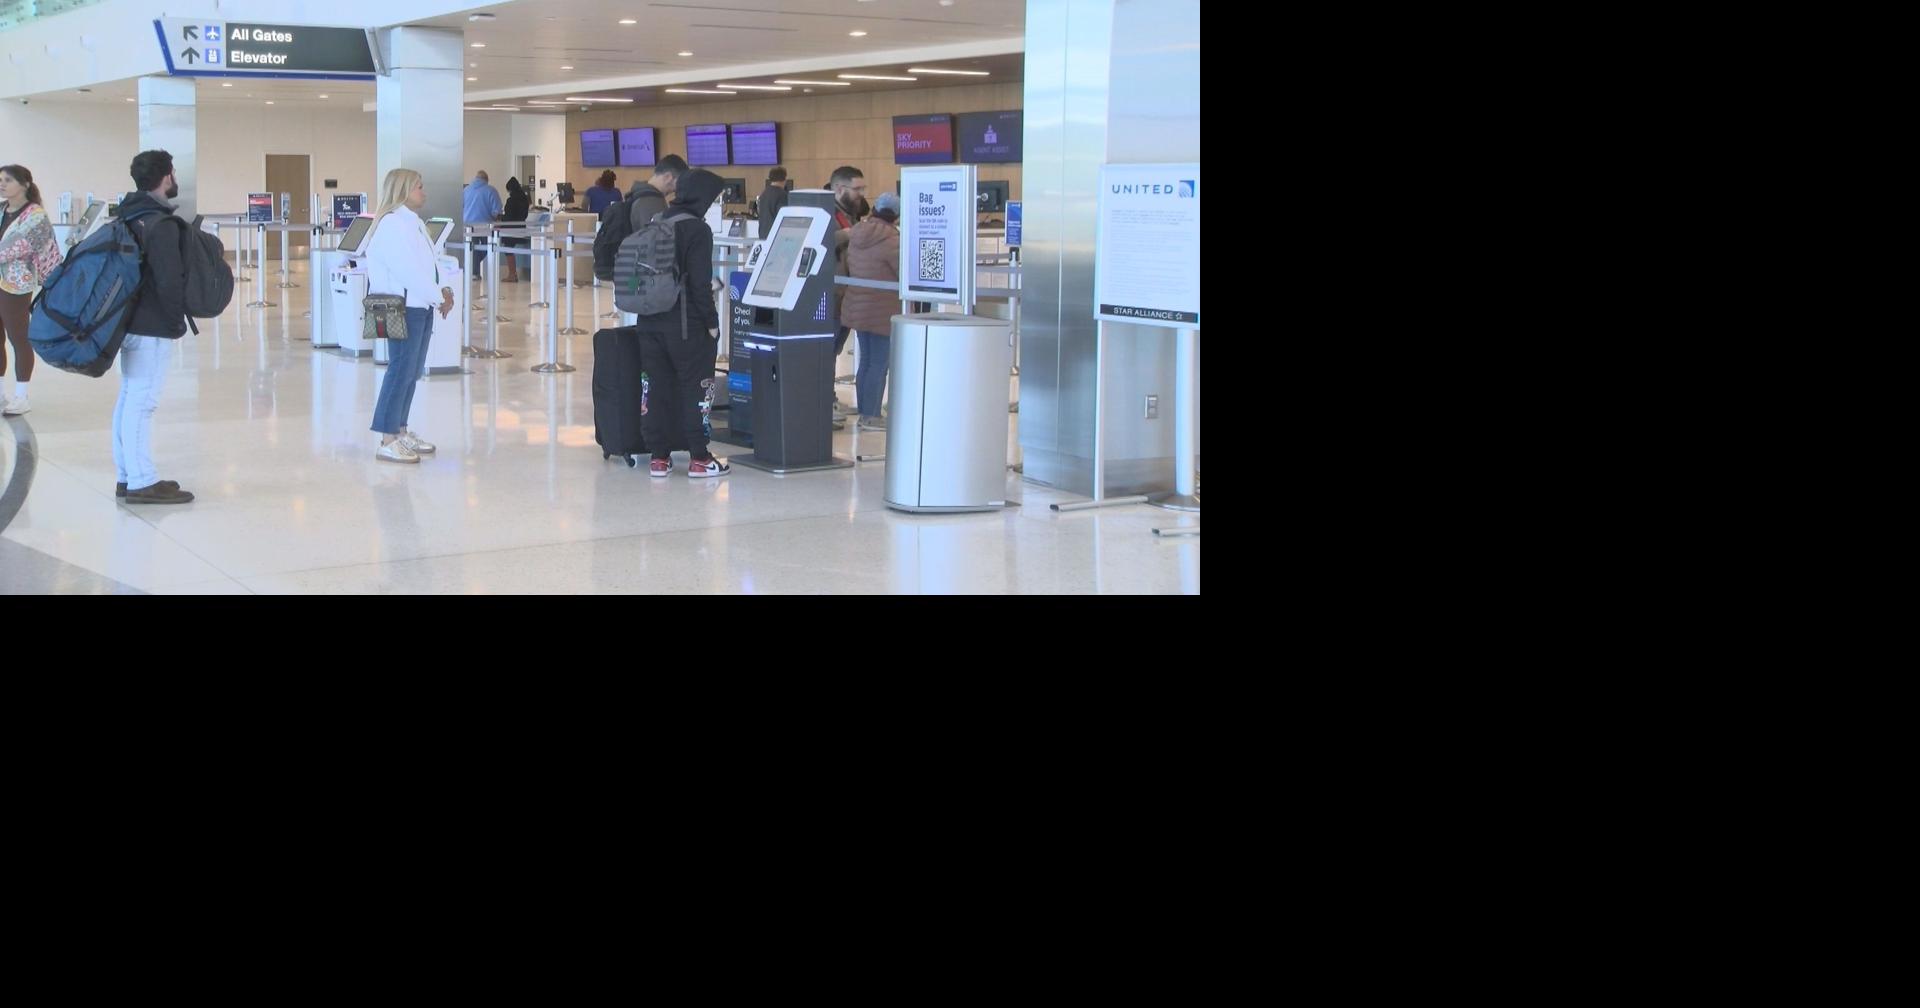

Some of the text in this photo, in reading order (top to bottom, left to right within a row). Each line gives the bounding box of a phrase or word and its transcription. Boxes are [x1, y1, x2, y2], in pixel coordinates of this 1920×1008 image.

[231, 28, 293, 43] All Gates
[231, 50, 287, 65] Elevator
[897, 133, 912, 141] SKY
[897, 140, 933, 149] PRIORITY
[1112, 184, 1174, 194] UNITED
[919, 192, 934, 205] Bag
[919, 205, 946, 216] issues?
[1113, 307, 1173, 320] STAR ALLIANCE
[734, 317, 741, 325] of
